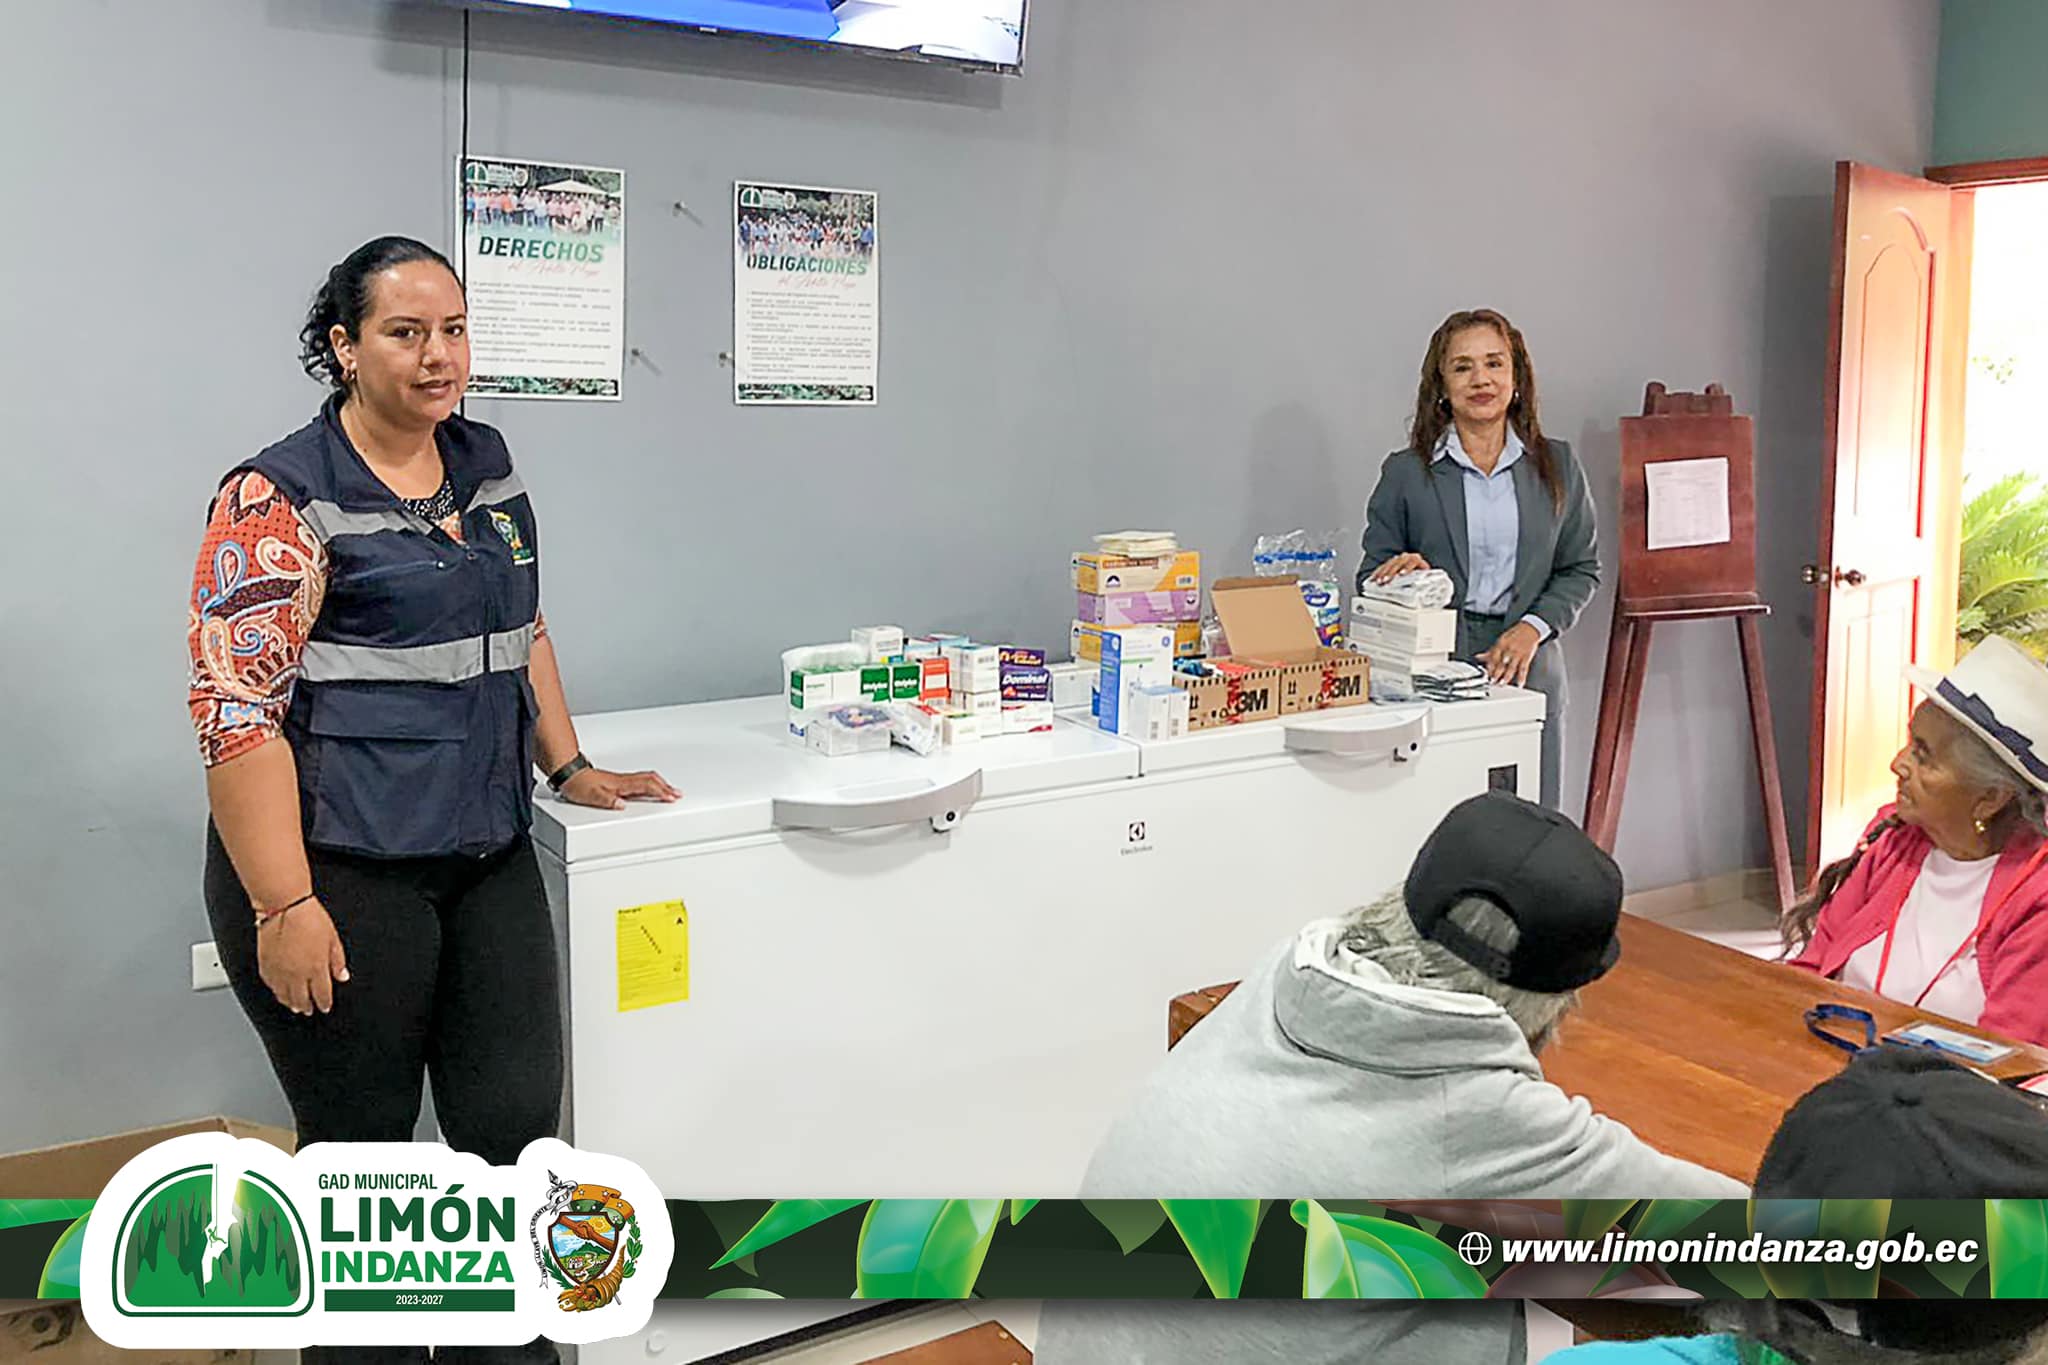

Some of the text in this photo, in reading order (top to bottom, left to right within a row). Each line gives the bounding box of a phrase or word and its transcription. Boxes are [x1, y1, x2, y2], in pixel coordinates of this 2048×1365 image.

[478, 236, 604, 263] DERECHOS
[746, 254, 868, 275] OBLIGACIONES
[1330, 675, 1361, 699] 3M
[1238, 688, 1269, 713] 3M
